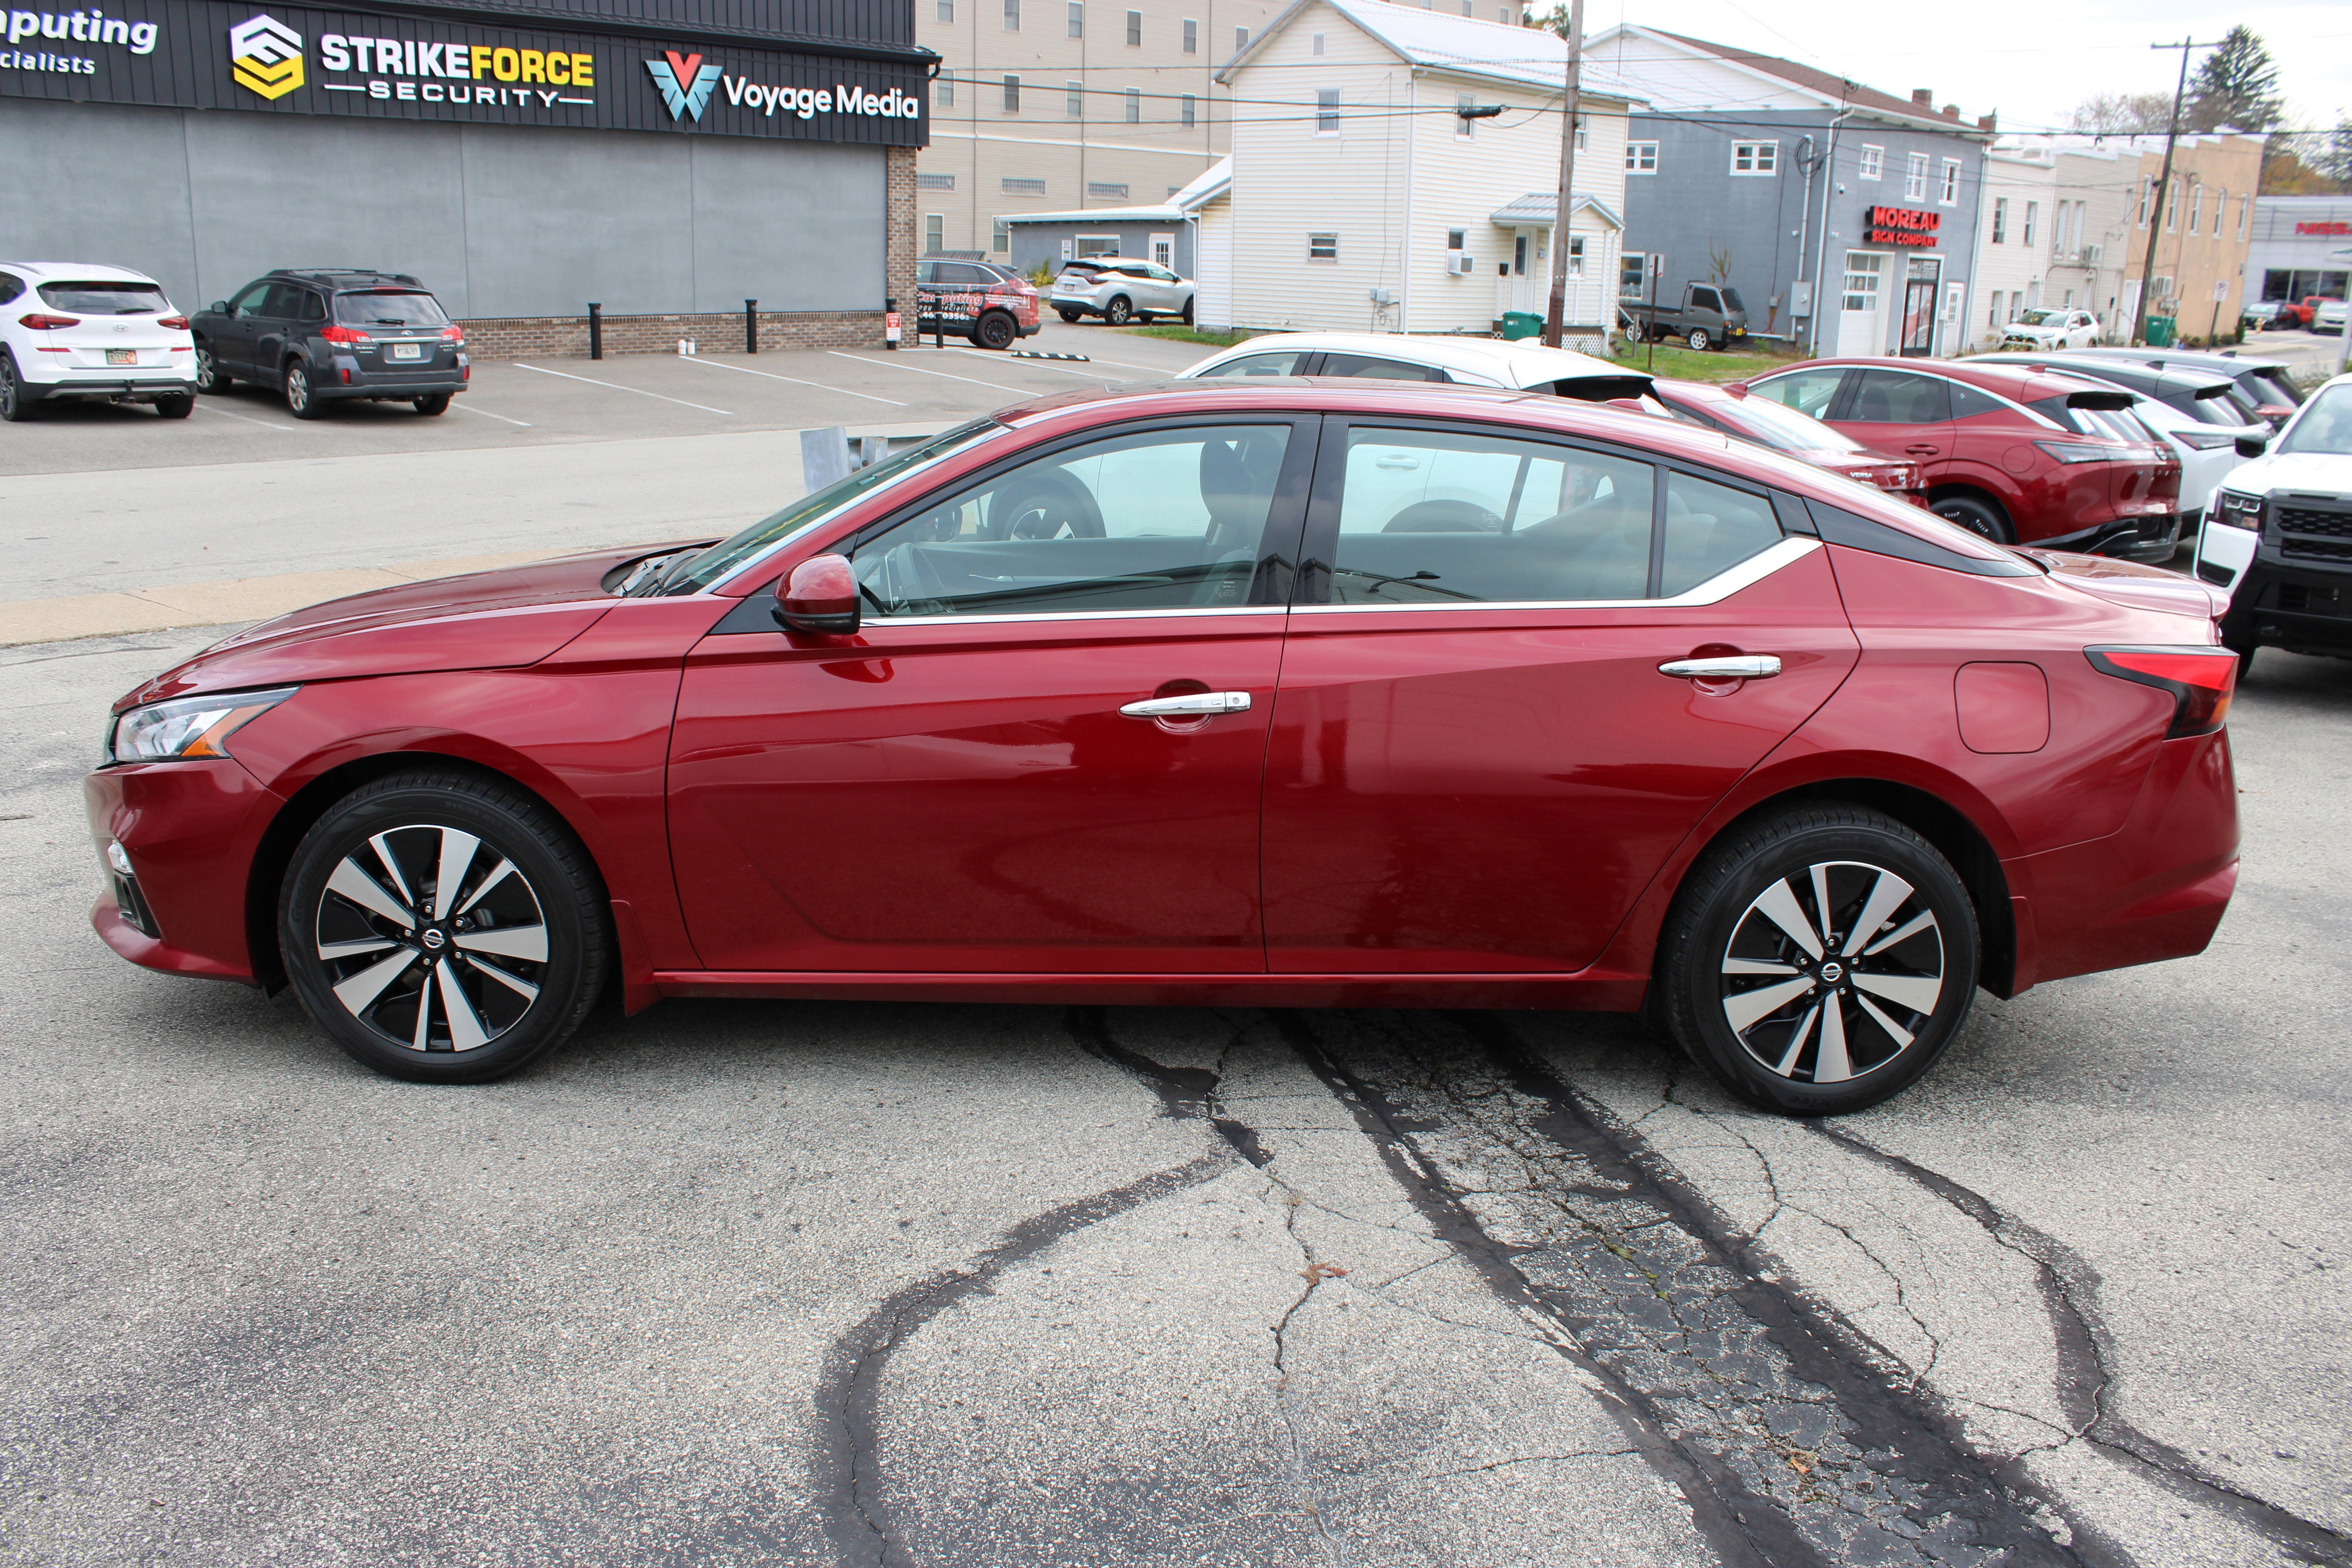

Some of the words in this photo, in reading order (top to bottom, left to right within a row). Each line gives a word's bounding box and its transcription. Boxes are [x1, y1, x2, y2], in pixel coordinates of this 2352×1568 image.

[321, 34, 593, 86] STRIKEFORCE
[369, 81, 558, 107] SECURITY
[723, 75, 831, 119] Voyage
[837, 85, 918, 119] Media
[1873, 205, 1941, 230] MOREAU
[1872, 229, 1895, 243] SIGN
[1897, 232, 1938, 247] COMPANY
[919, 291, 983, 306] Coputing
[423, 935, 443, 943] NISSAN
